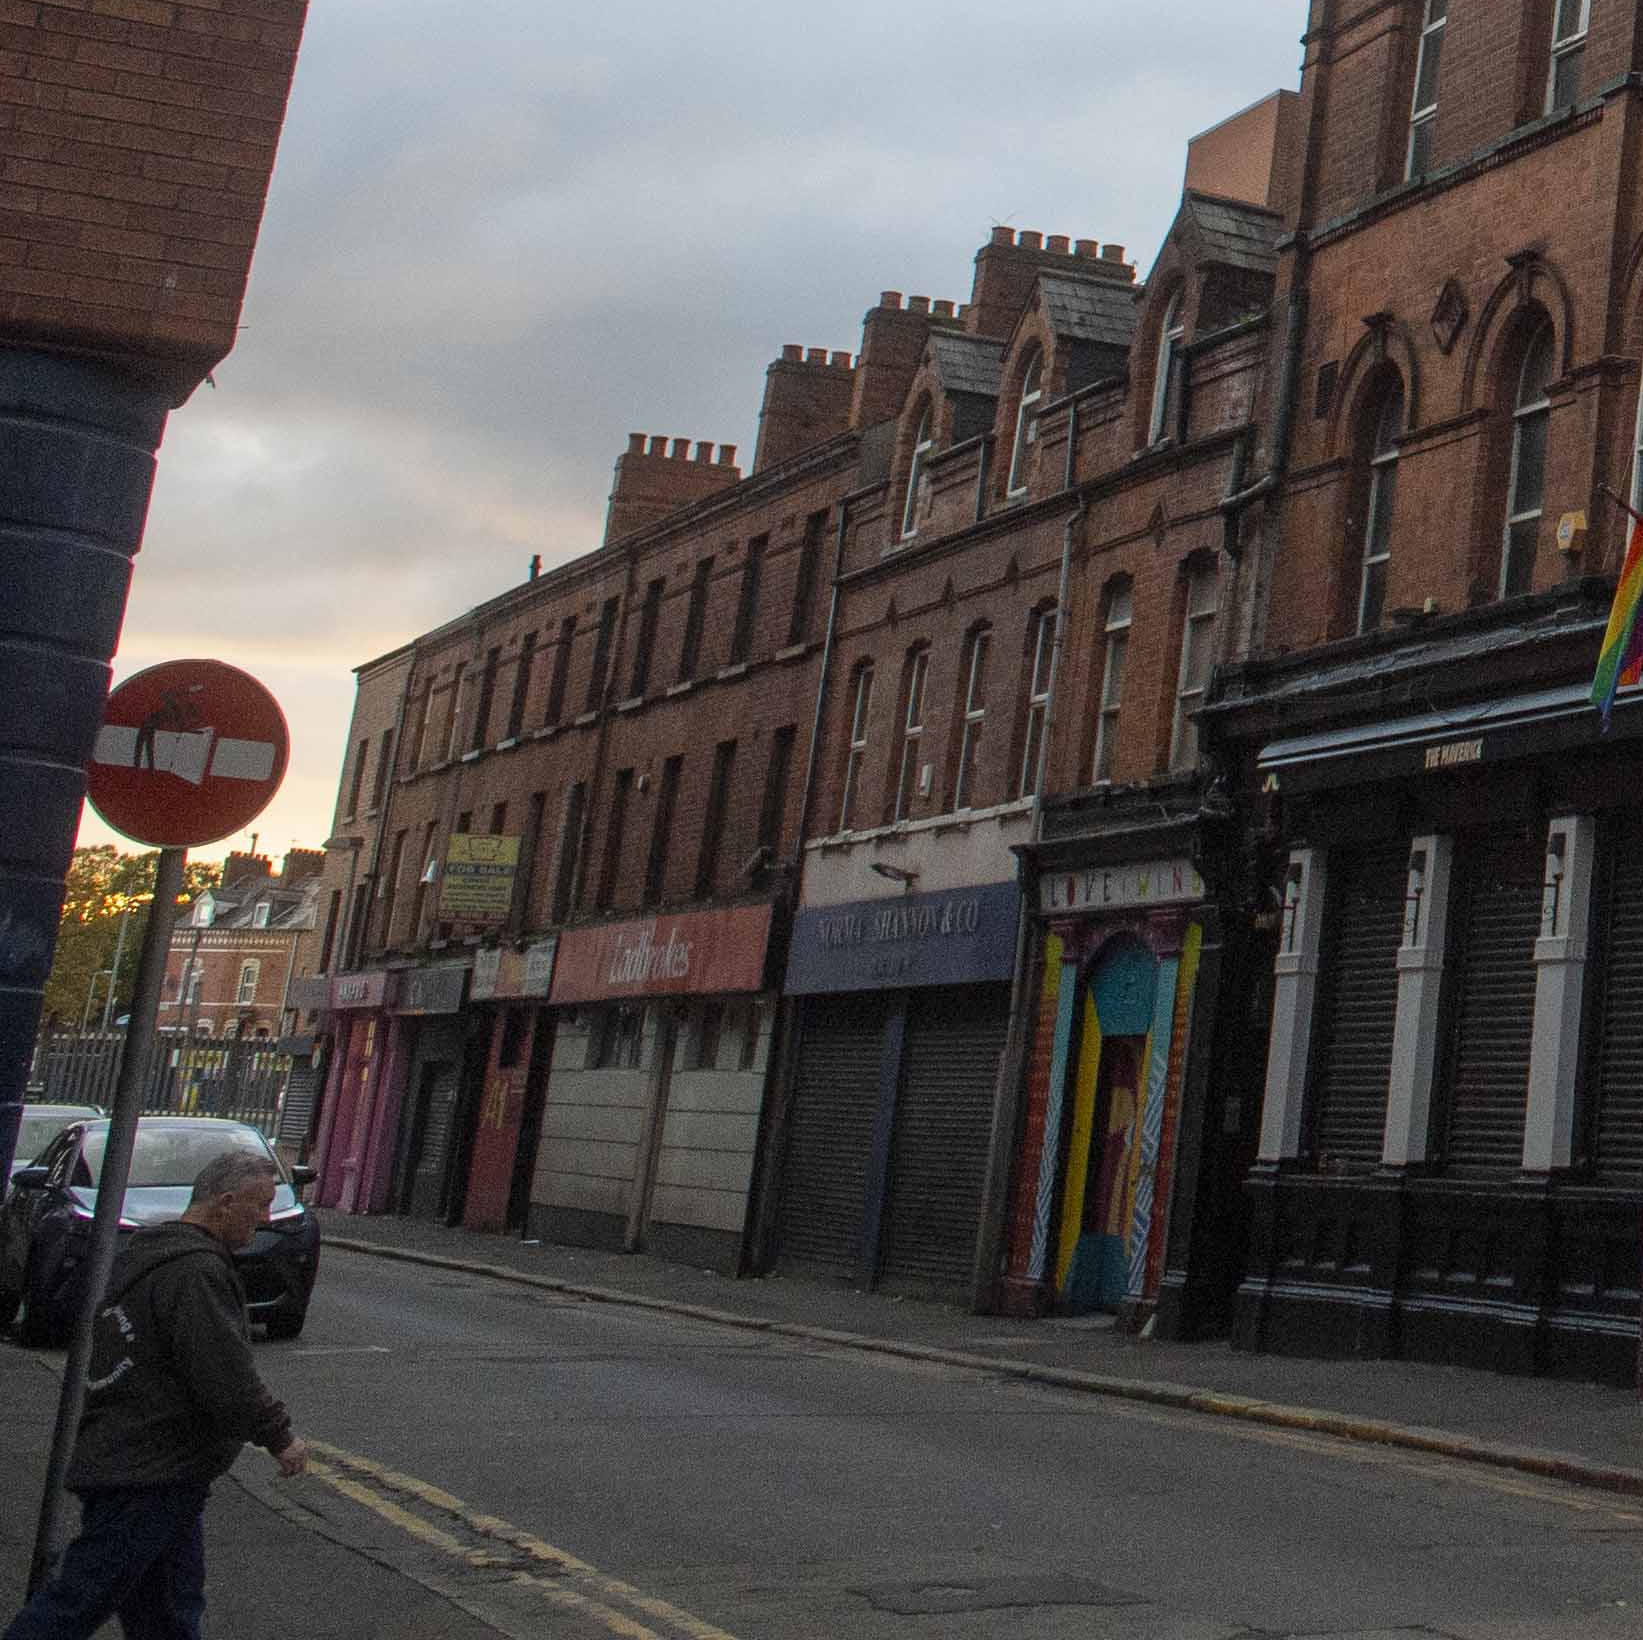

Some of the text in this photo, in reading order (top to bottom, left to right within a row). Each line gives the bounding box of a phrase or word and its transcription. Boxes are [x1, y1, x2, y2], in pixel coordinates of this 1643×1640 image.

[1425, 738, 1484, 769] THE MAVERICK
[1050, 872, 1112, 907] LOVE
[609, 927, 692, 984] Ladbrokes
